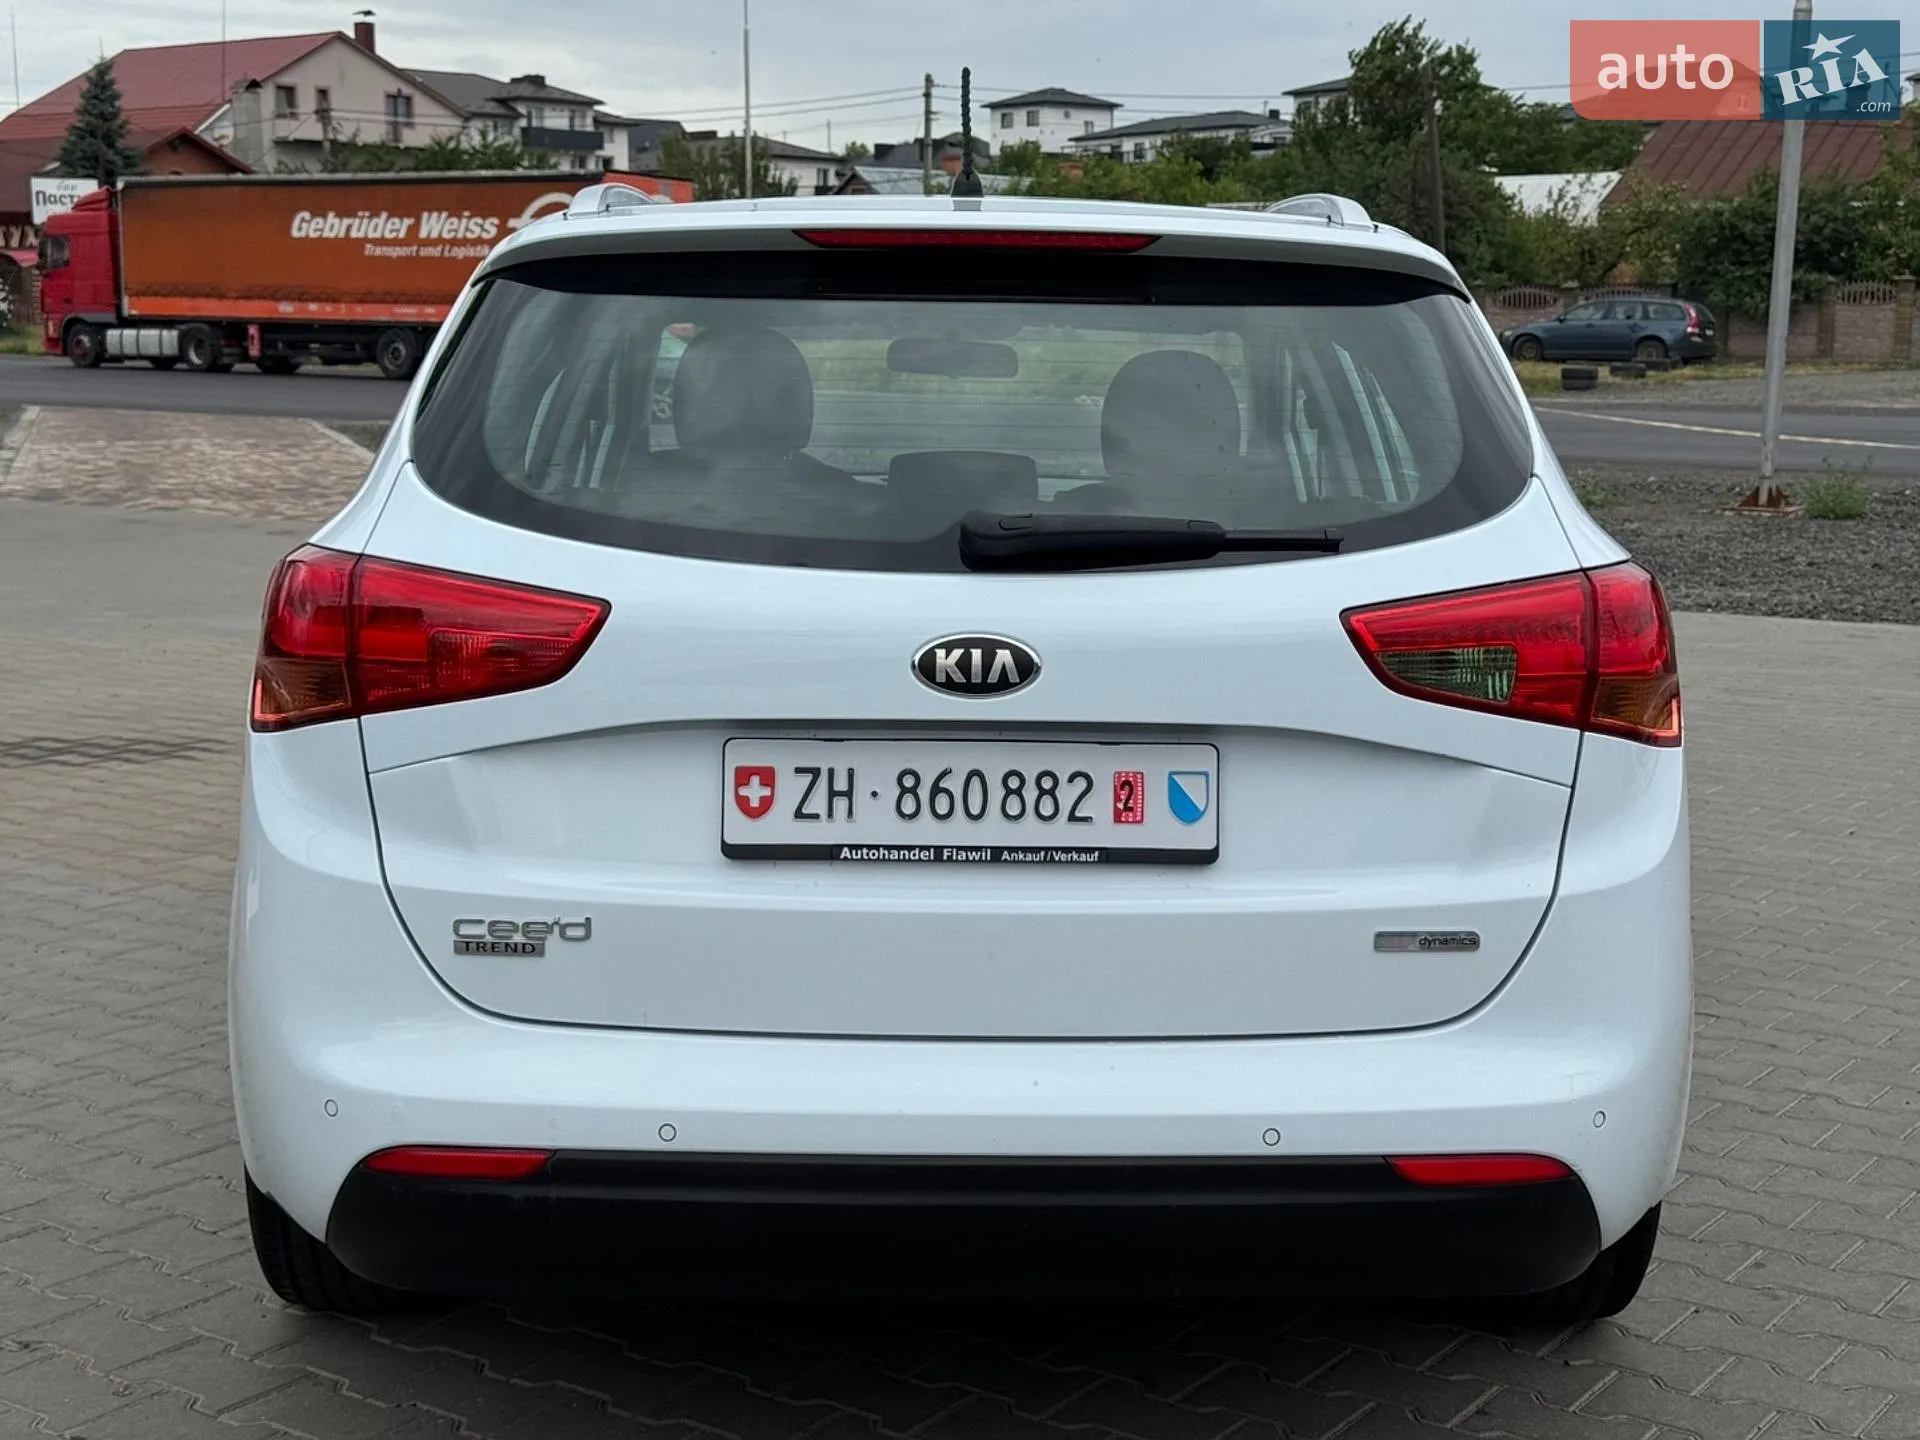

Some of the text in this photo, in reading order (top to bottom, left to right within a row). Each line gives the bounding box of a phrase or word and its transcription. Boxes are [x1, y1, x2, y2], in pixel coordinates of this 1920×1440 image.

[290, 210, 500, 240] Gebrüder Weiss
[364, 243, 417, 258] Transport
[418, 244, 442, 257] und
[934, 648, 1020, 683] KIA
[792, 766, 856, 820] ZH
[896, 766, 1095, 824] 860882
[1119, 779, 1135, 812] 2
[839, 846, 935, 861] Autohandel
[942, 847, 991, 862] Flawil
[464, 941, 536, 954] TREND
[1418, 935, 1477, 949] dynamics
